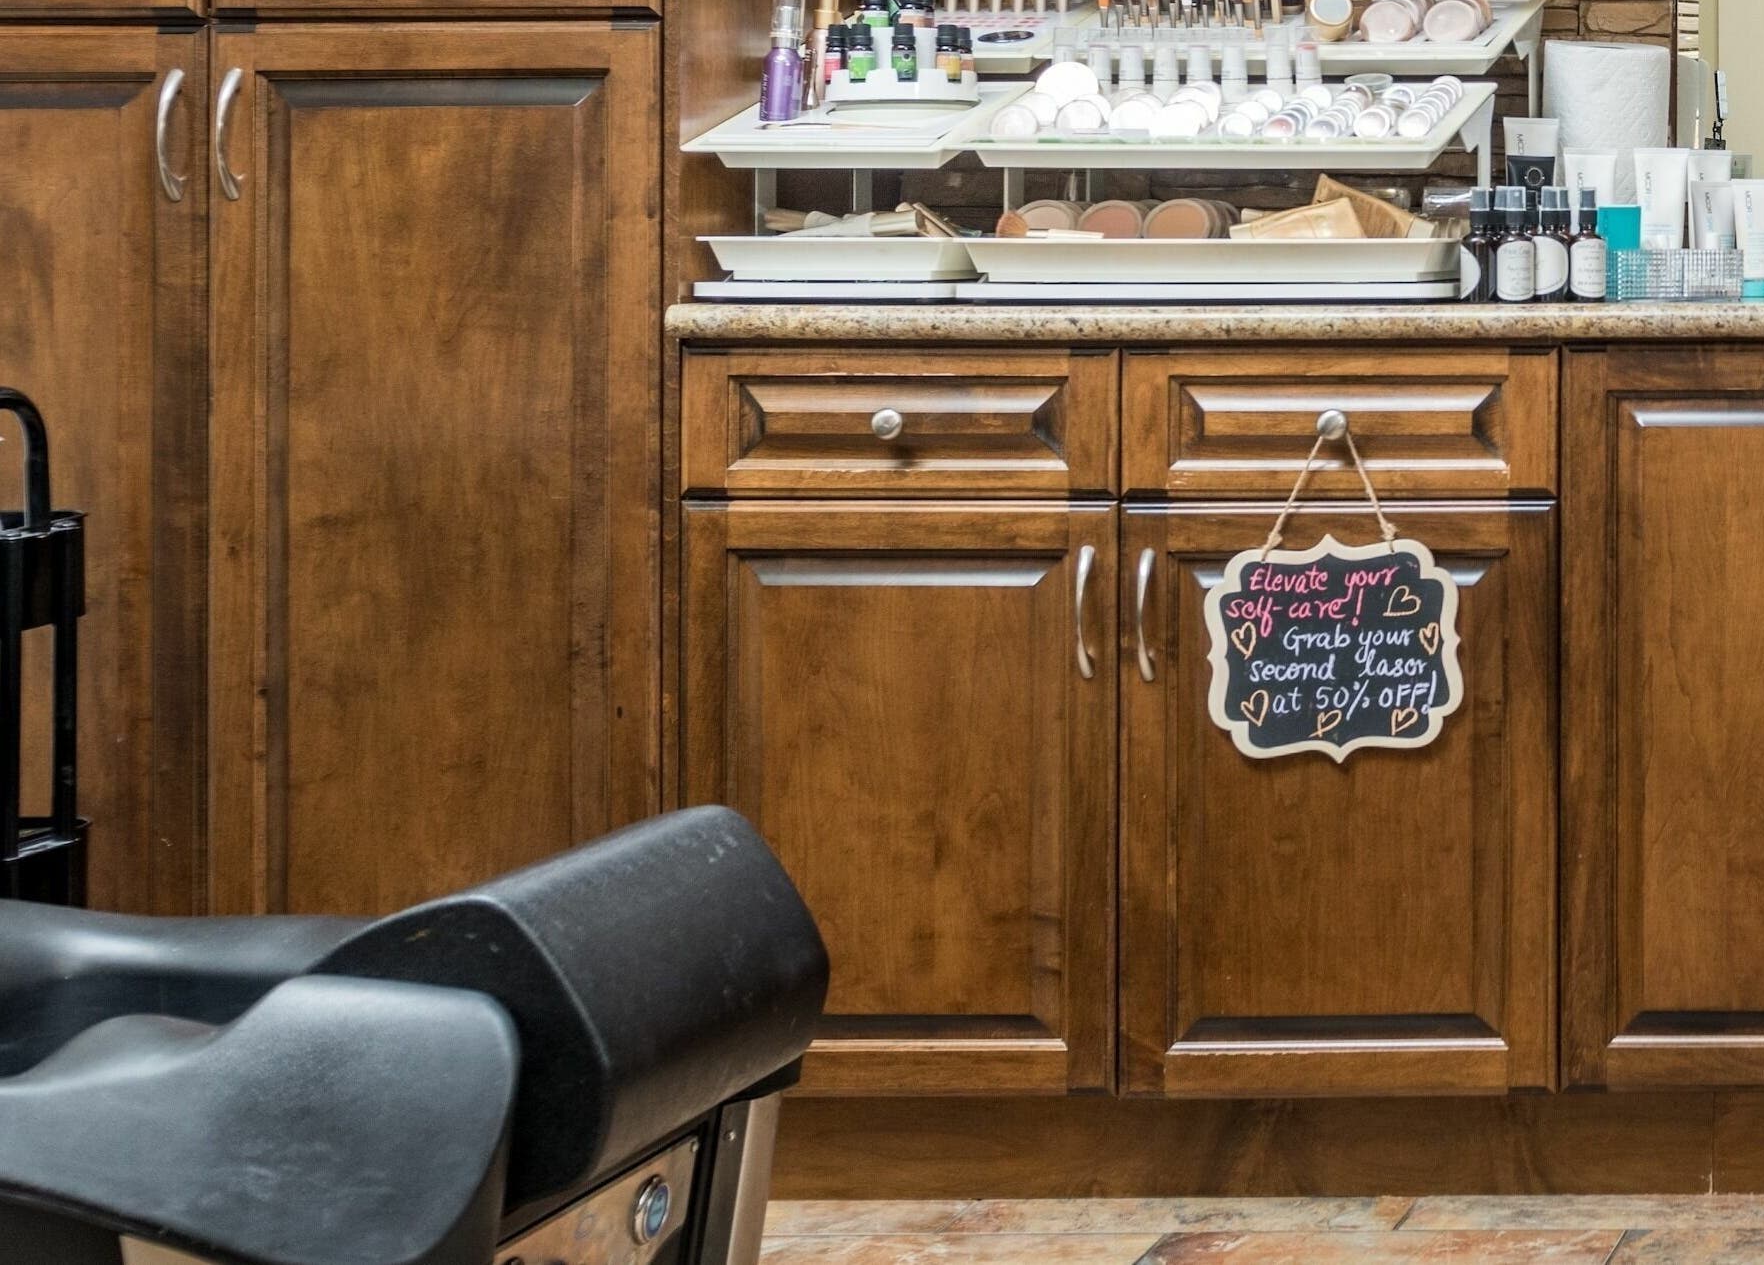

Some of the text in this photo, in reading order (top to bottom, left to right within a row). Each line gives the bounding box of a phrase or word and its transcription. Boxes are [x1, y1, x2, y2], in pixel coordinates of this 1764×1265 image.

[1250, 566, 1399, 602] Elevate your
[1283, 624, 1414, 663] Grab your
[1250, 654, 1335, 682] second
[1272, 687, 1302, 714] at
[1316, 680, 1370, 721] 50%
